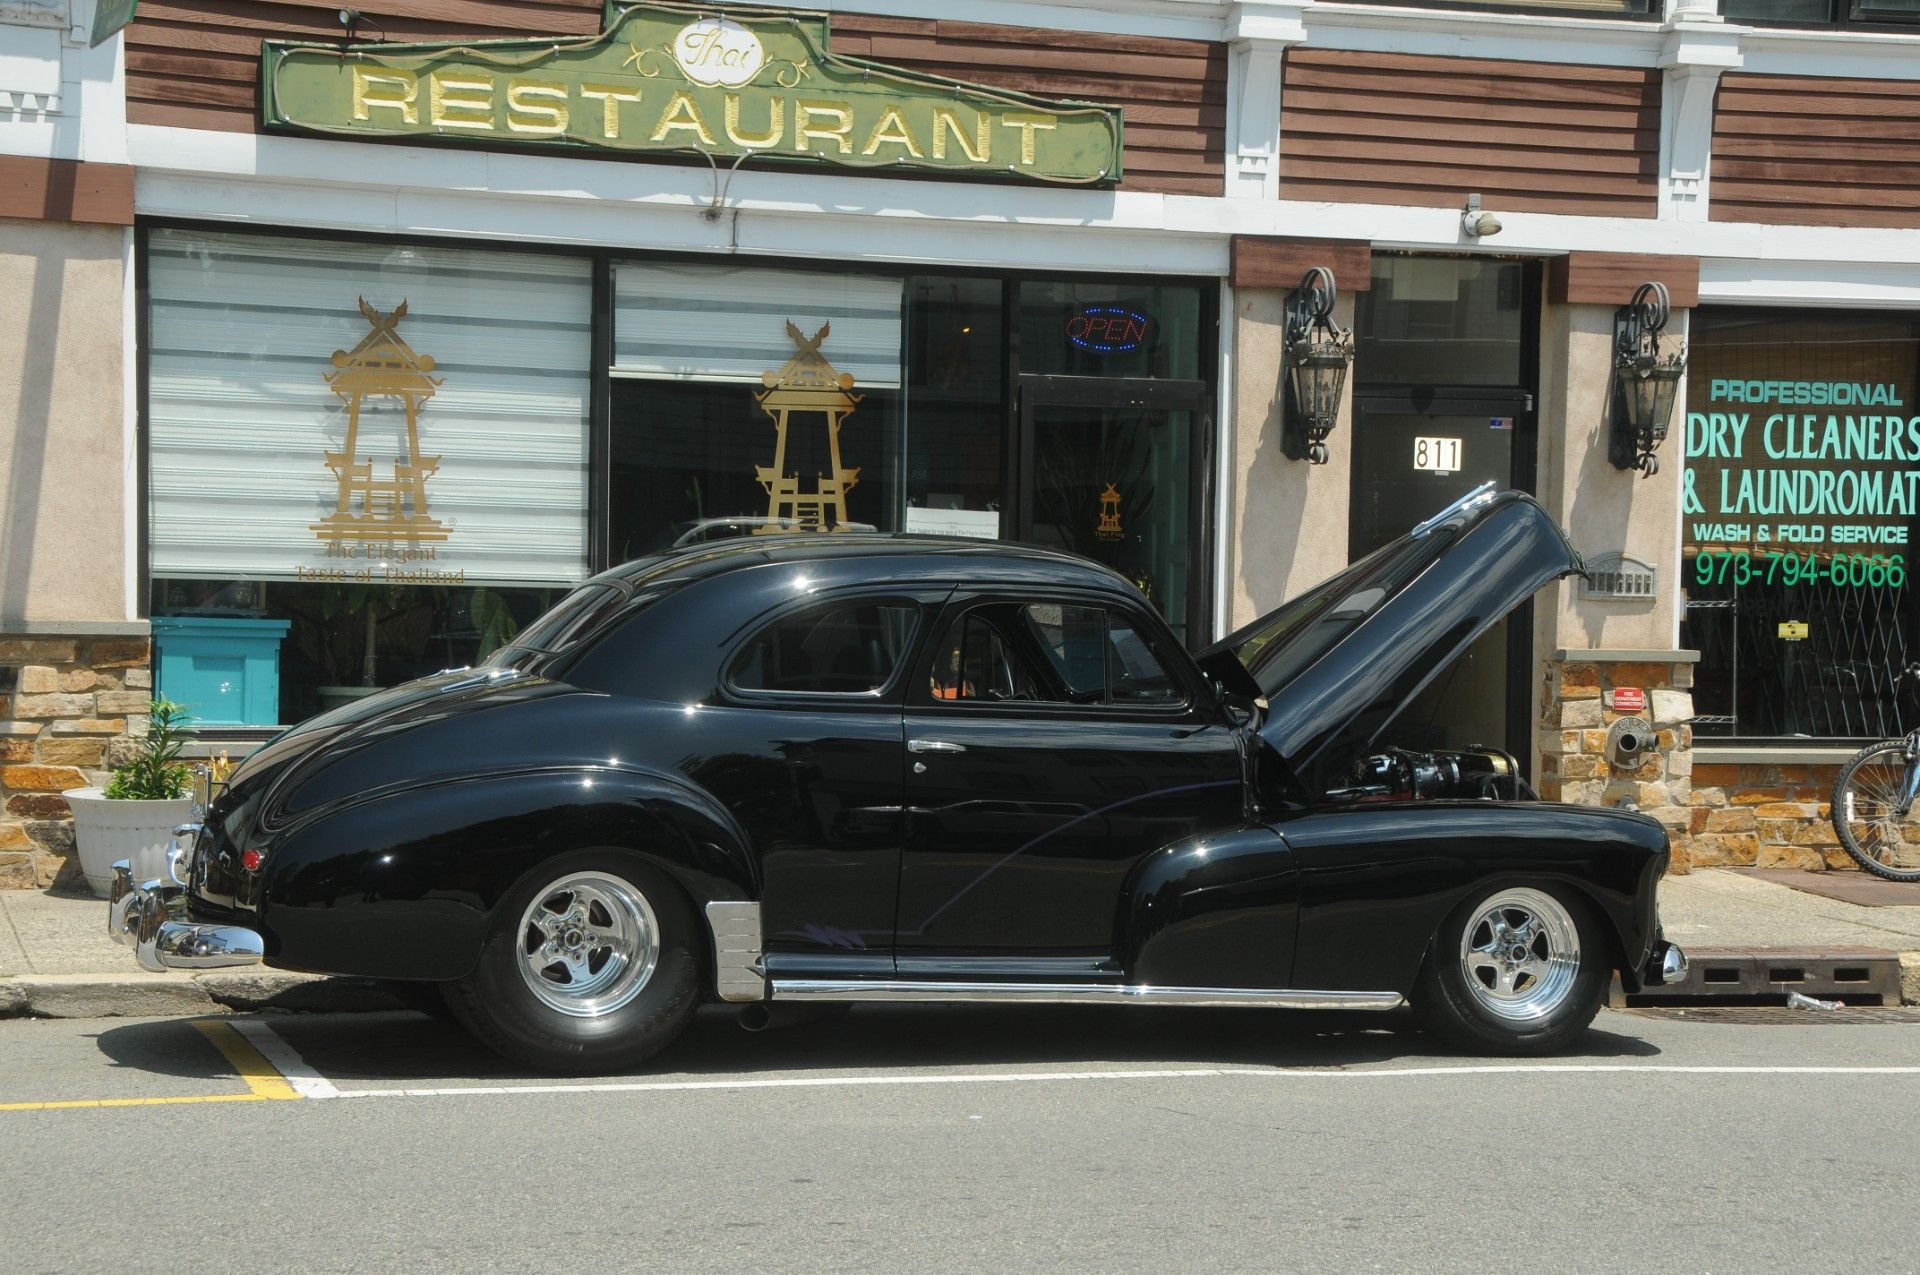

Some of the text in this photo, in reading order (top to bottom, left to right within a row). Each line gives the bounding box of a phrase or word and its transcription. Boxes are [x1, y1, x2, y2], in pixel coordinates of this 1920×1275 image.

[684, 26, 756, 69] Thai
[351, 63, 1058, 167] RESTAURANT
[1065, 316, 1148, 342] OPEN
[1711, 379, 1904, 406] PROFESSIONAL
[1686, 412, 1920, 461] DRY CLEANERS
[1416, 438, 1457, 469] 811
[1683, 468, 1920, 516] & LAUNDROMAT
[1693, 523, 1909, 544] WASH & FOLD SERVICE
[325, 542, 438, 564] The Elegant
[295, 565, 465, 584] Taste of Thailand
[1695, 550, 1905, 588] 973-794-6066
